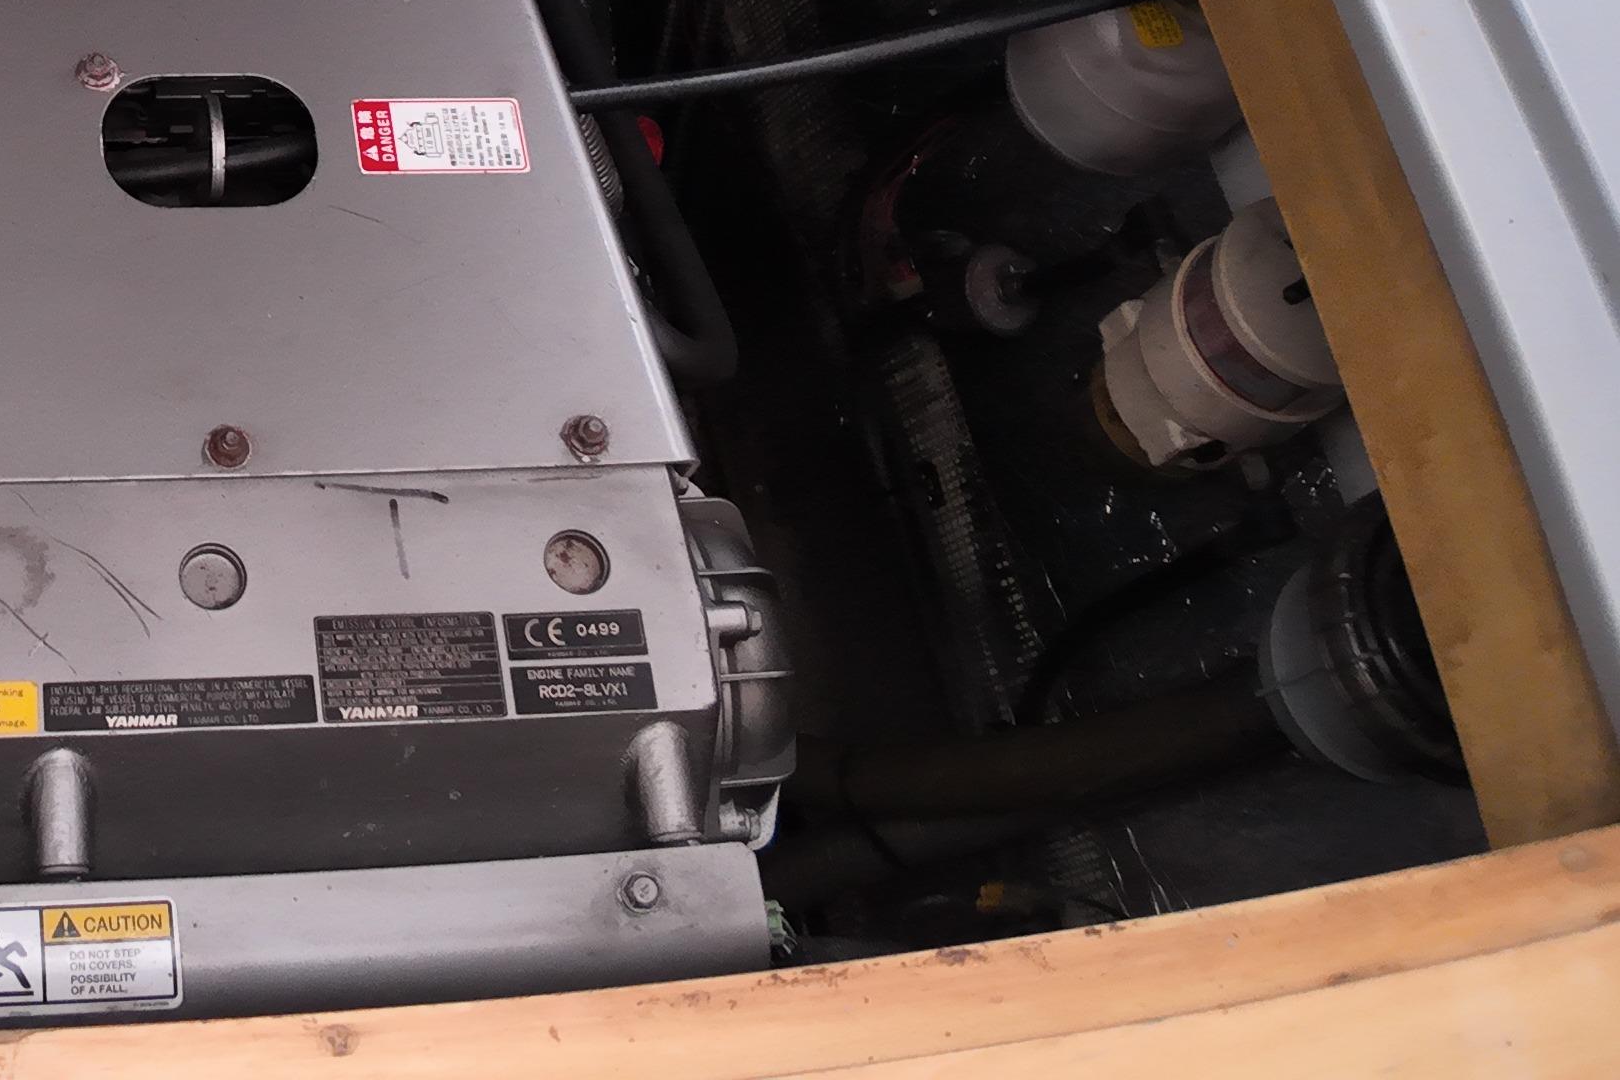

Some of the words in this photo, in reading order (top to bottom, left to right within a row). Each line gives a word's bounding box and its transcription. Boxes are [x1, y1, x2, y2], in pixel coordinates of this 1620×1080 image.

[376, 110, 396, 162] DANGER
[524, 617, 566, 647] CE
[576, 622, 620, 637] 0499
[526, 669, 564, 680] ENGINE
[567, 667, 605, 680] FAMILY
[609, 666, 637, 677] NAME
[100, 684, 118, 694] THIS
[538, 682, 628, 699] RCD2-8LVX1
[141, 704, 150, 714] TO
[338, 705, 418, 720] YANMAR
[105, 714, 178, 728] YANMAR
[83, 914, 162, 933] CAUTION
[69, 951, 86, 961] DO
[88, 950, 110, 960] NOT
[114, 948, 141, 958] STEP
[70, 962, 86, 972] ON
[88, 959, 137, 970] COVERS.
[70, 972, 136, 984] POSSIBILITY
[70, 986, 86, 996] OF
[88, 985, 96, 994] A
[100, 984, 128, 994] FALL.
